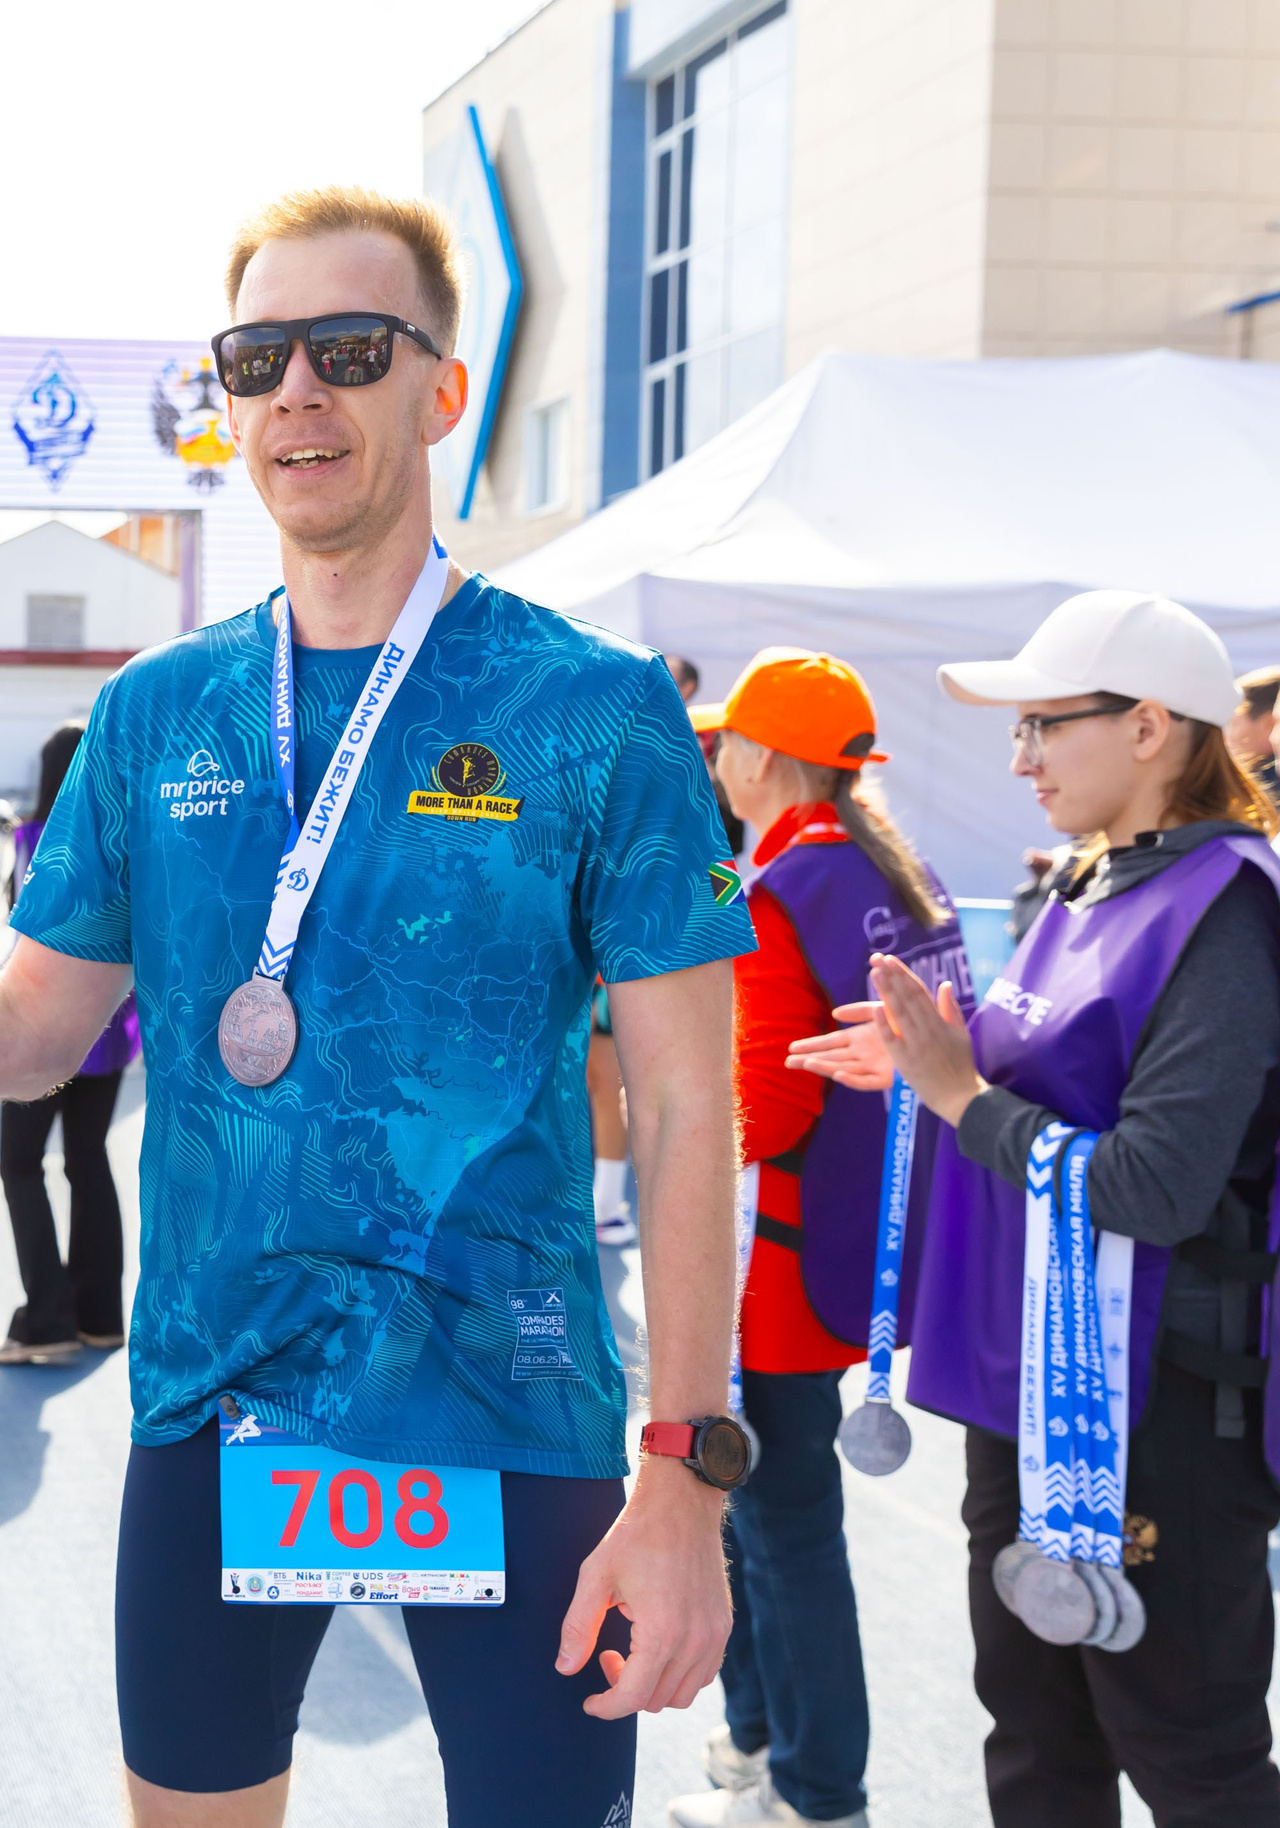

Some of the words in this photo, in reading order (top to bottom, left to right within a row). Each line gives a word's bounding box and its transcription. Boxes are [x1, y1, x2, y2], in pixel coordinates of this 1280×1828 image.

[348, 642, 405, 745] ДИНАМО
[278, 736, 290, 767] XV
[306, 750, 356, 844] БЕЖИТ!
[416, 796, 445, 808] MORE
[448, 797, 473, 810] THAN
[475, 799, 483, 811] A
[485, 800, 513, 815] RACE
[169, 798, 229, 822] sport
[510, 1299, 525, 1310] 98
[517, 1355, 559, 1364] 08.06.25
[271, 1469, 450, 1549] 708
[296, 1571, 322, 1581] Nika
[362, 1572, 384, 1580] UDS
[369, 1591, 399, 1600] Effort
